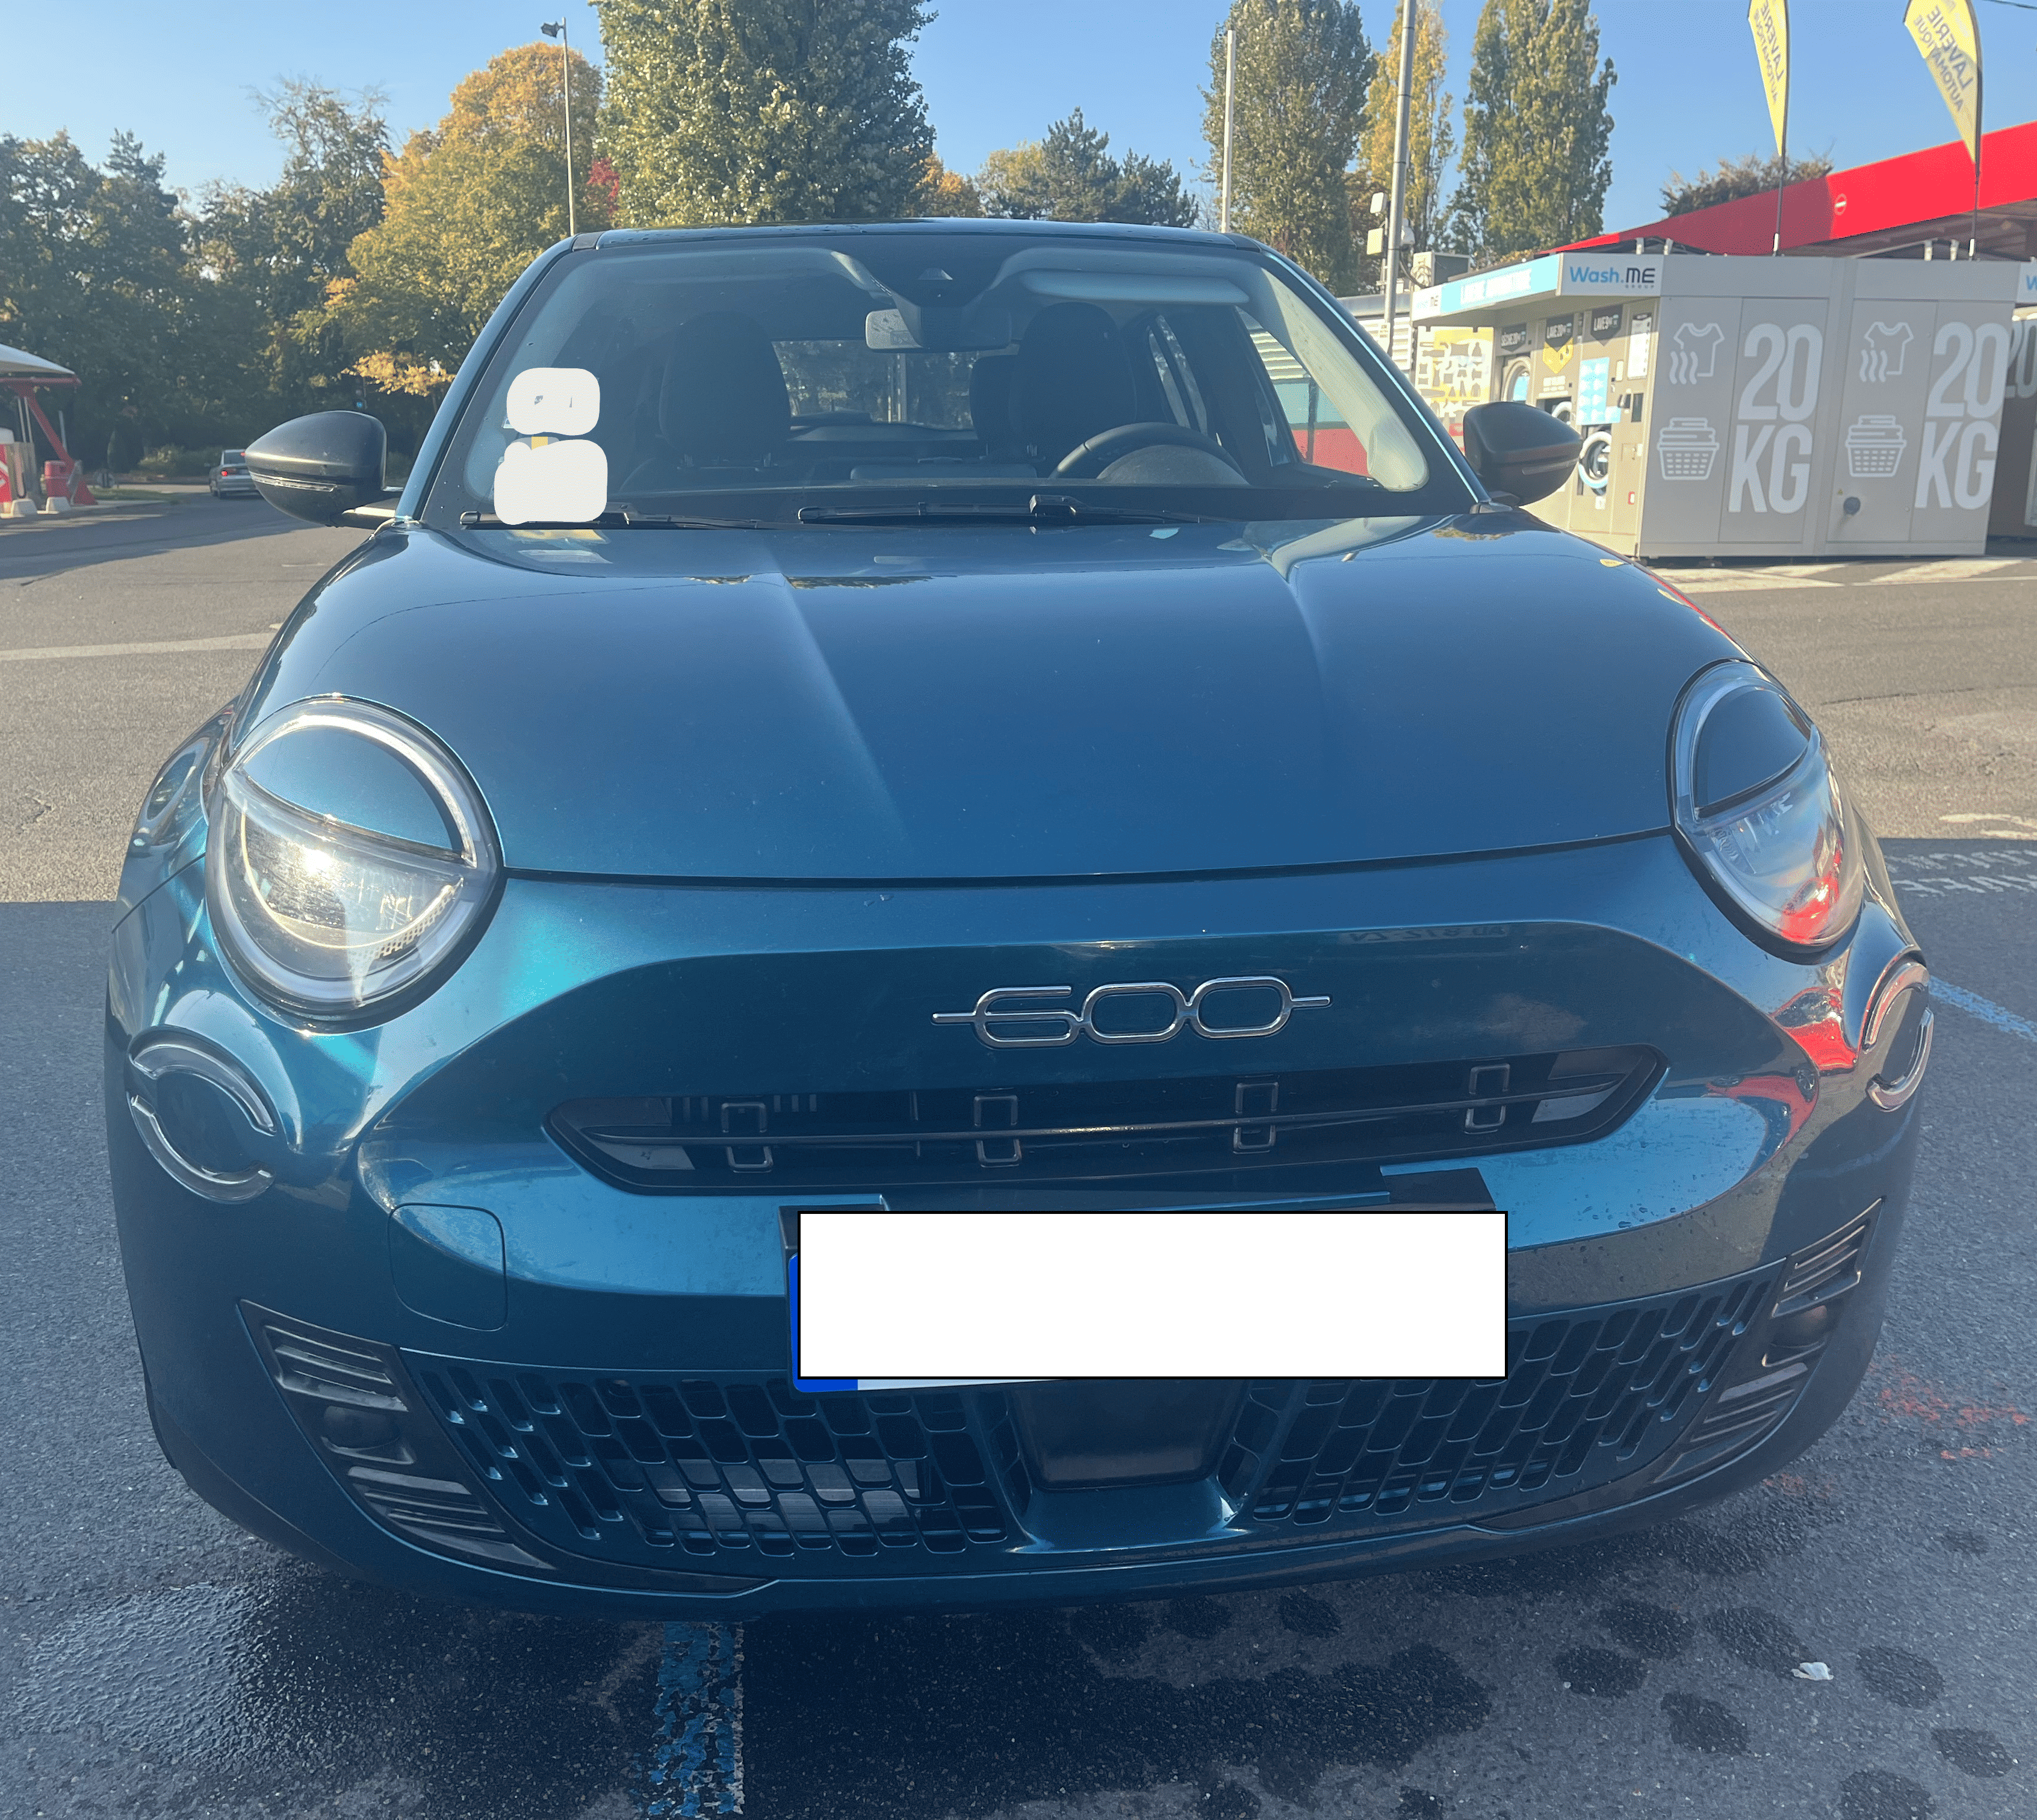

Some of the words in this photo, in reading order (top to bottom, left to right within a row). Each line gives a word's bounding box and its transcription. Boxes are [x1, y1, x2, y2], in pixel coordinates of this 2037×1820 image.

[1737, 323, 1823, 421] 20
[1926, 322, 2011, 418] 20
[1728, 424, 1812, 513] KG
[1914, 421, 1998, 510] KG
[958, 975, 1306, 1050] 600
